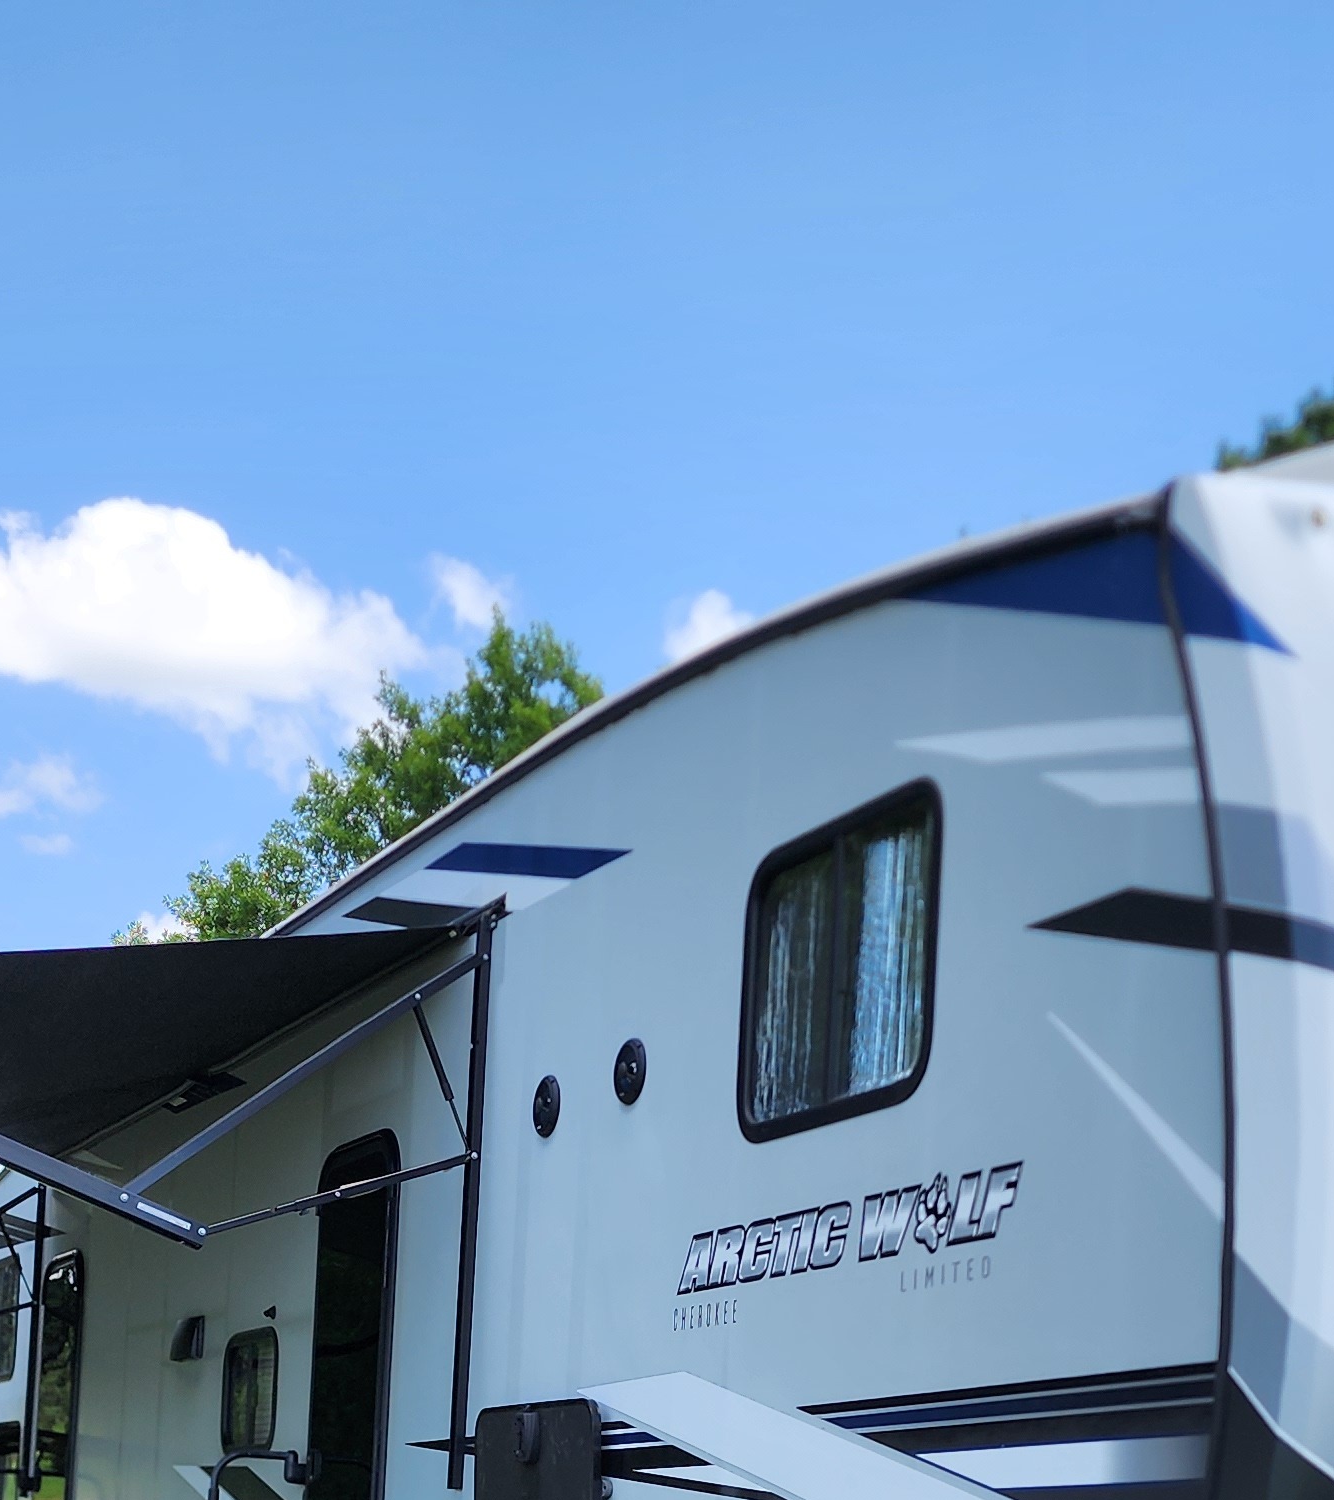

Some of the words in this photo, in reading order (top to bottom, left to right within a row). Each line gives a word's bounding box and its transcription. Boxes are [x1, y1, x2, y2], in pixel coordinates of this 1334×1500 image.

[676, 1201, 851, 1295] ARCTIC
[899, 1255, 992, 1292] LIMITED
[672, 1299, 738, 1332] CHEROKEE
